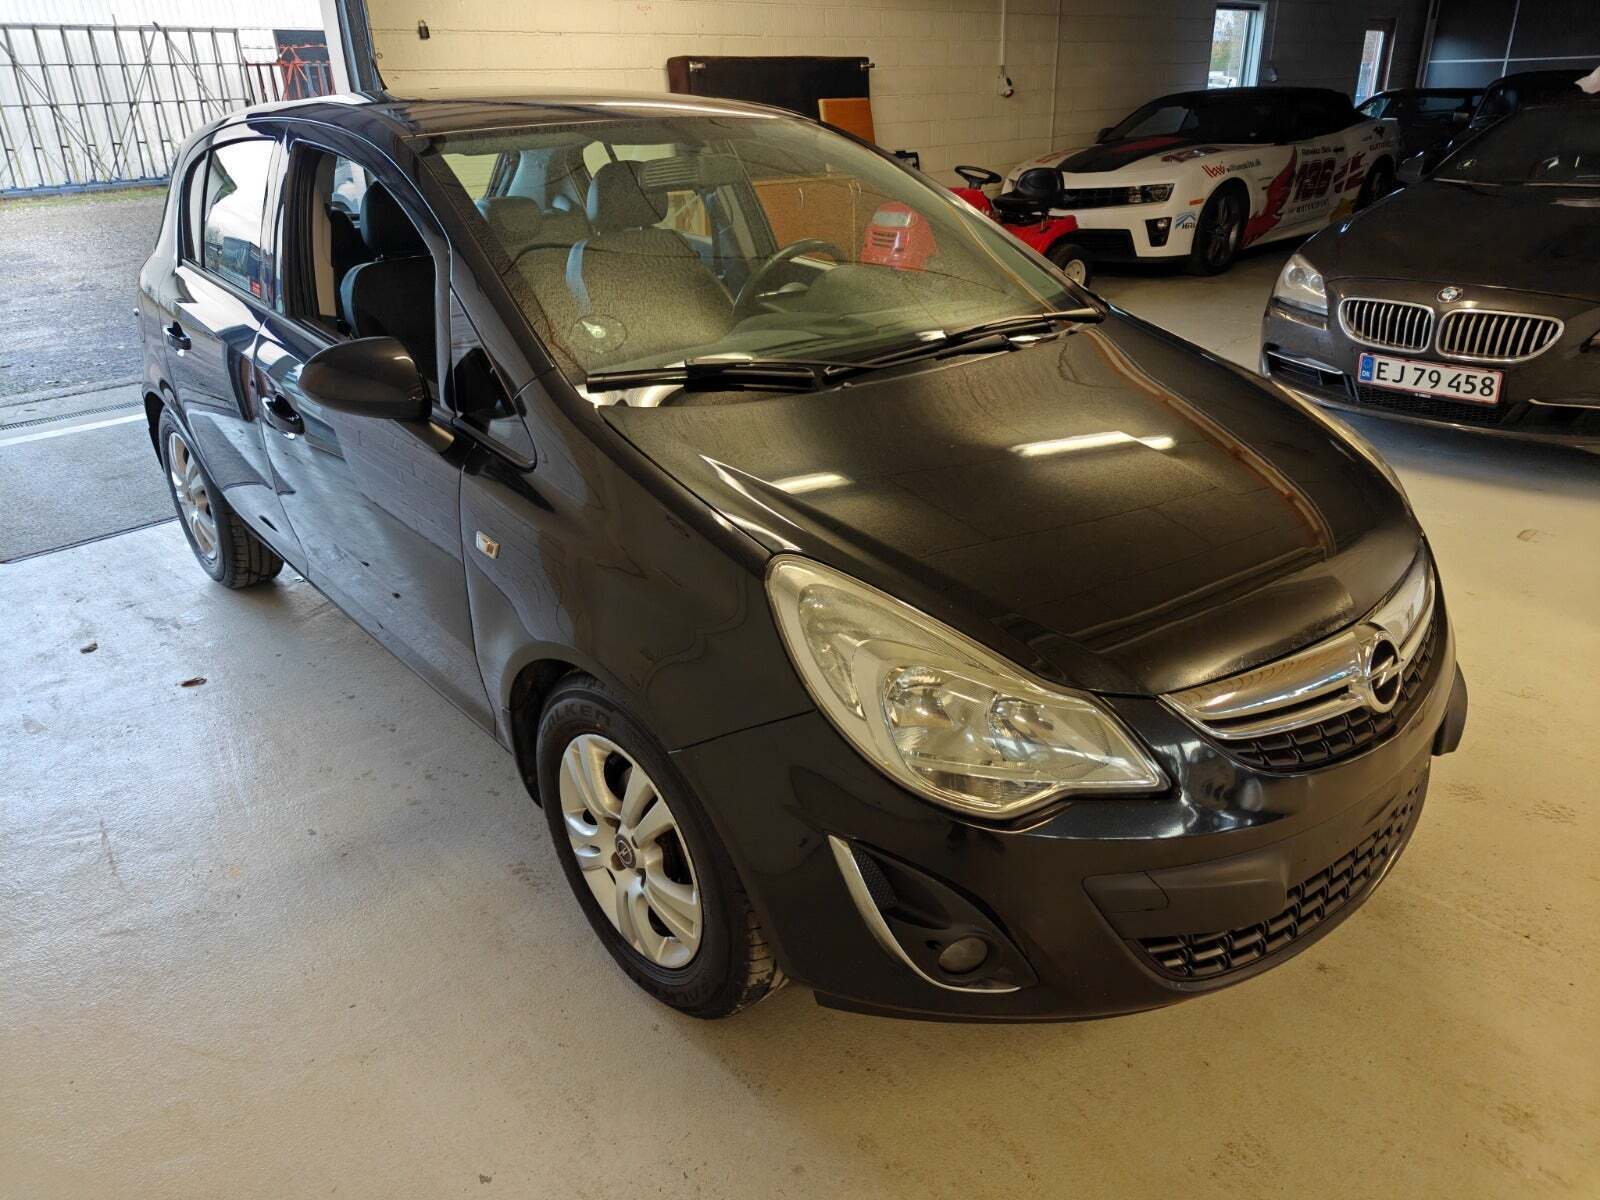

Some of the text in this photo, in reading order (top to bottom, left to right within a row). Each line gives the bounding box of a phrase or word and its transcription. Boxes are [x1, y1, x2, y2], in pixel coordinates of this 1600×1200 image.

[1376, 361, 1495, 397] EJ 79 458
